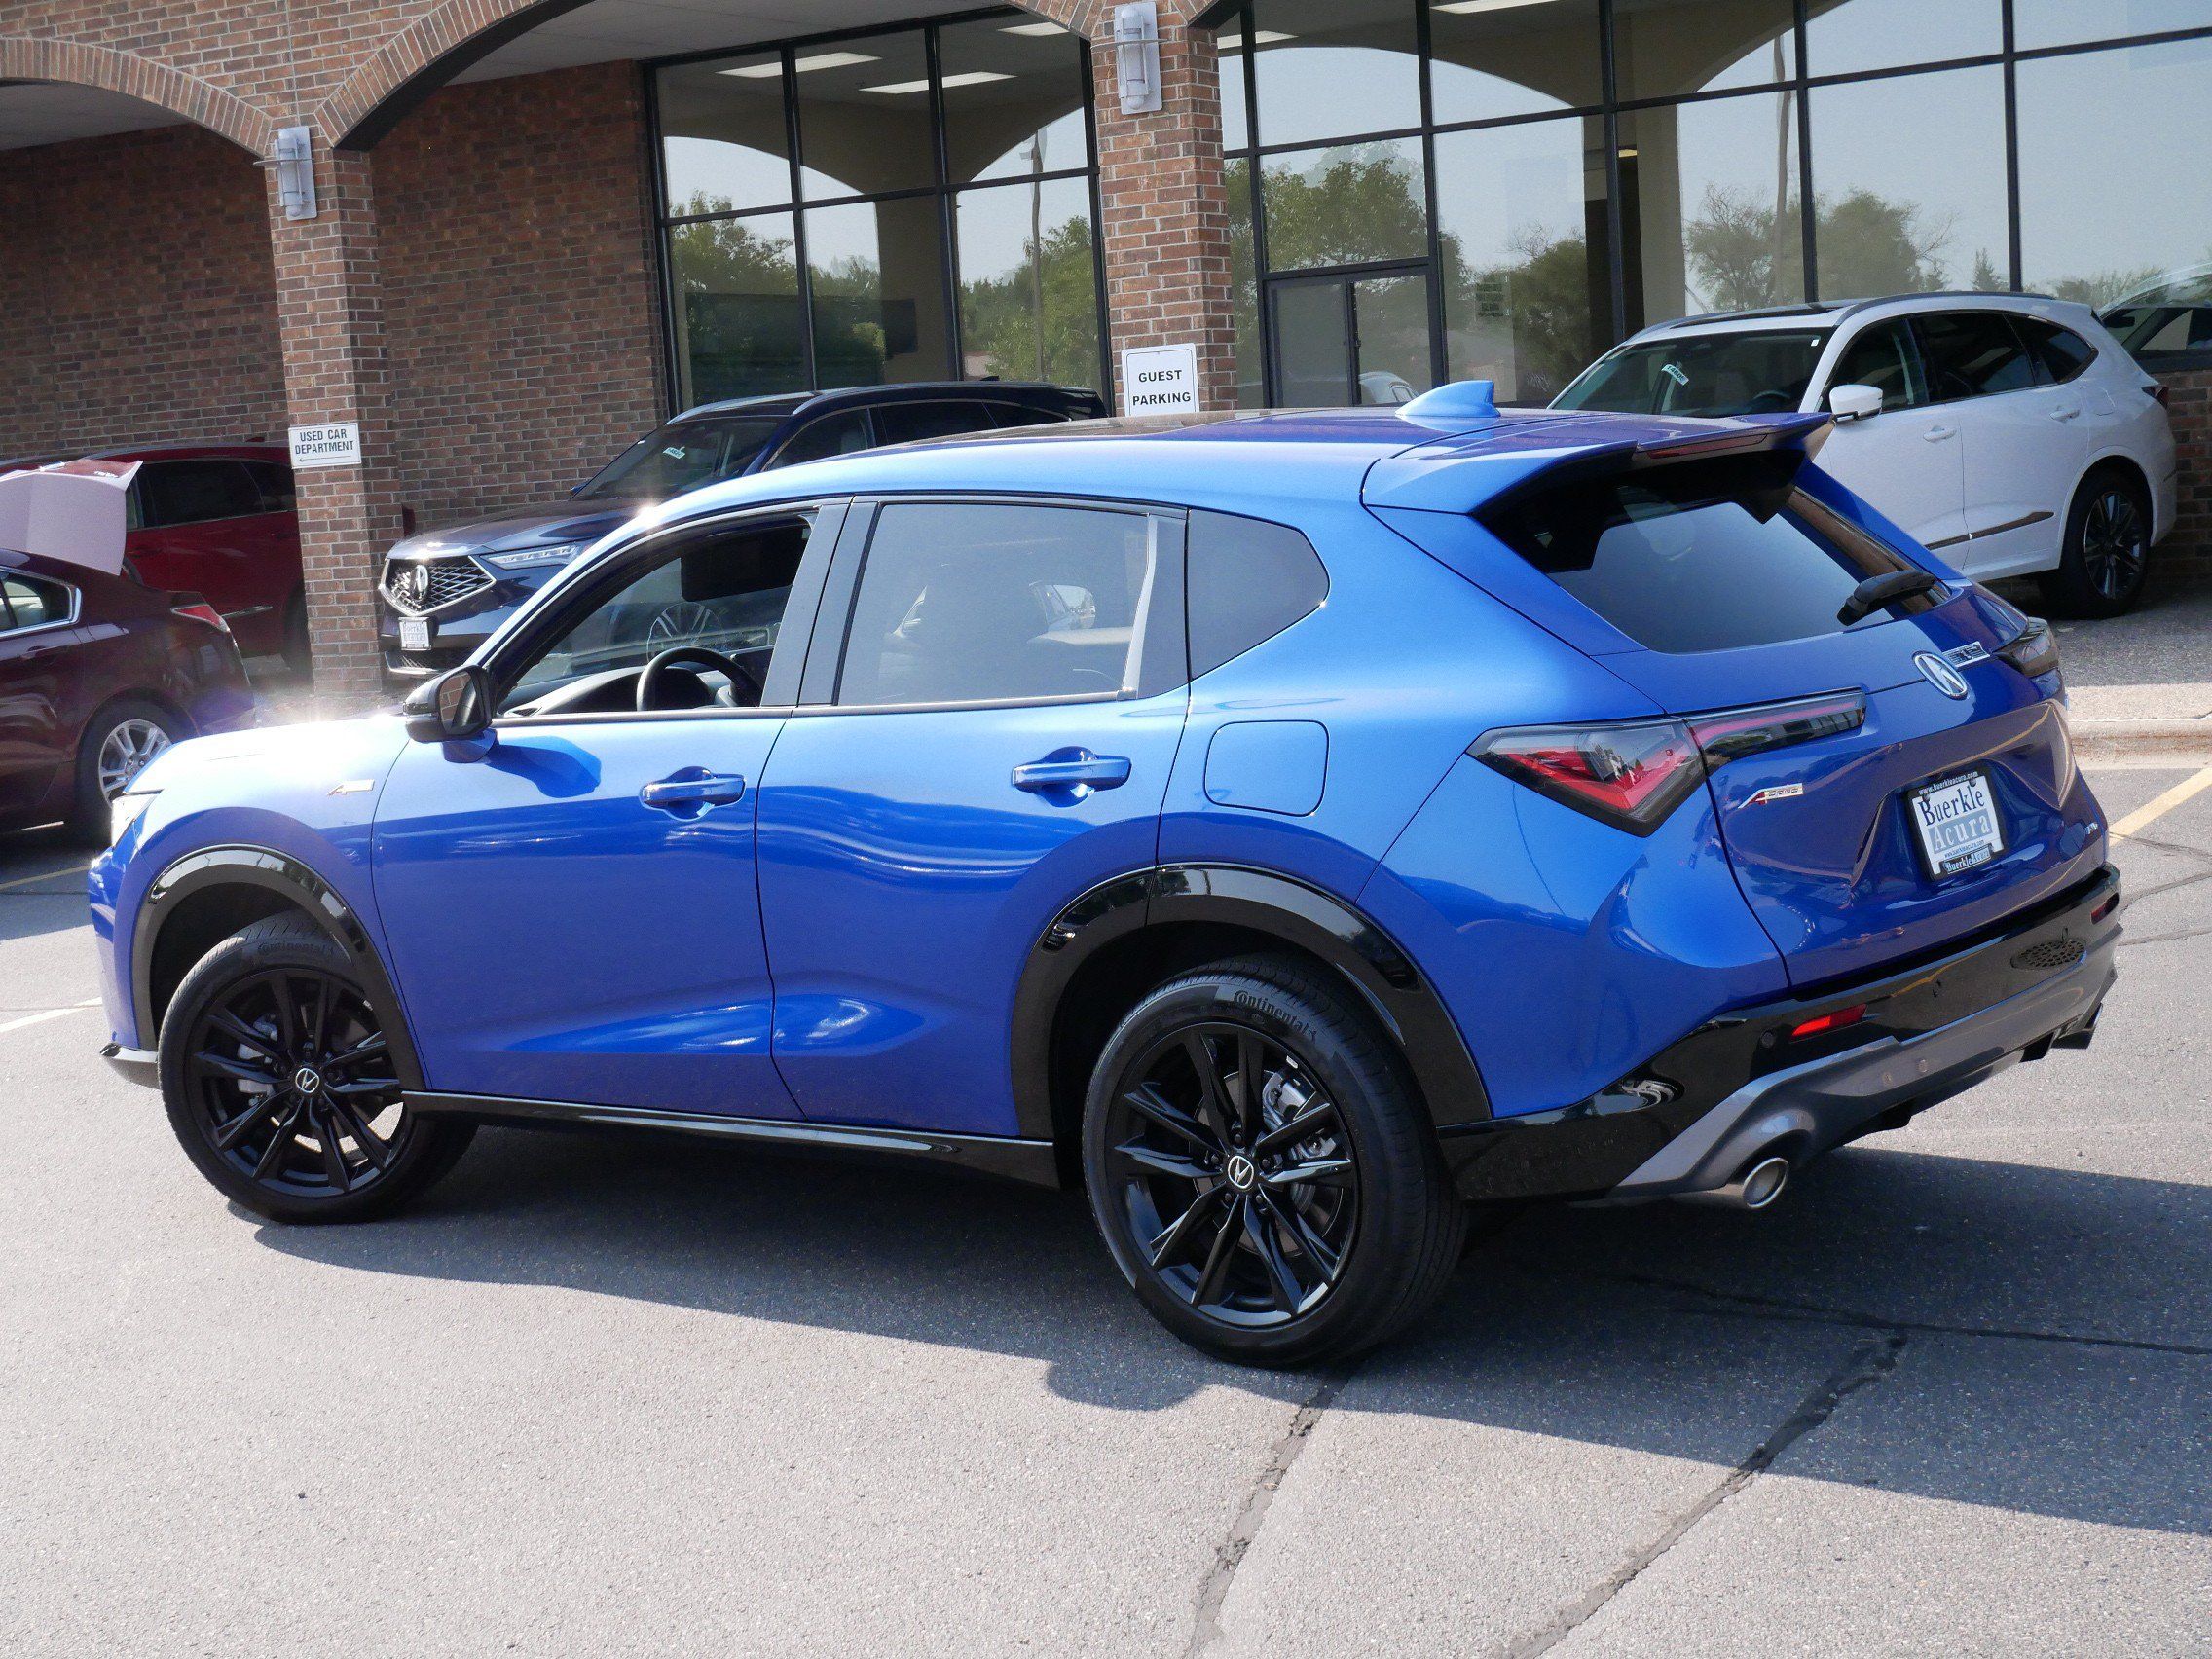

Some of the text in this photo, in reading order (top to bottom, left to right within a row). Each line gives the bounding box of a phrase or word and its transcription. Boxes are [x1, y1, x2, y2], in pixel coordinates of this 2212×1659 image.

[1138, 370, 1182, 382] GUEST
[1132, 392, 1191, 406] PARKING
[300, 428, 347, 442] USED CAR
[295, 440, 353, 455] DEPARTMENT
[1918, 785, 1985, 827] Buerkle
[1933, 815, 1991, 852] Acura
[1234, 990, 1309, 1034] Continental
